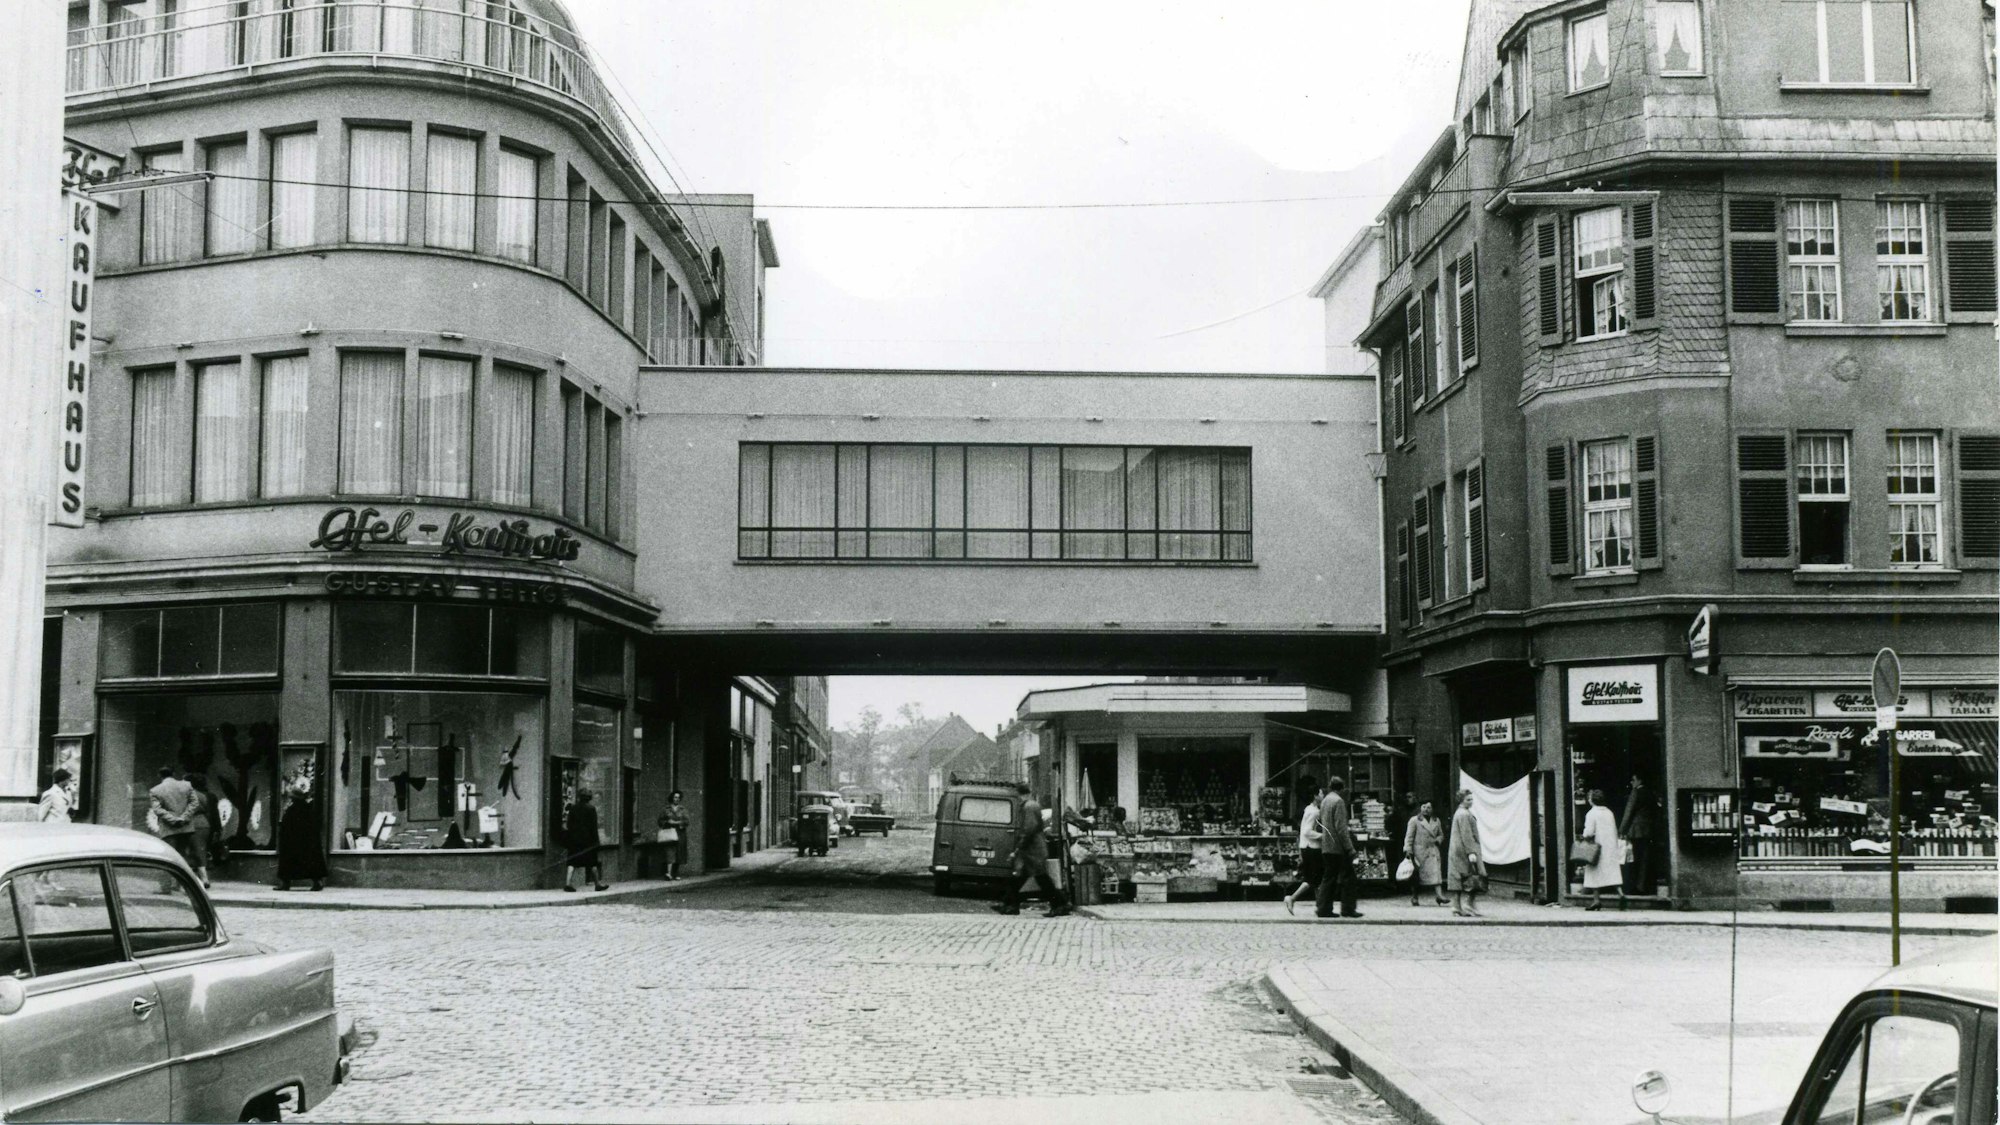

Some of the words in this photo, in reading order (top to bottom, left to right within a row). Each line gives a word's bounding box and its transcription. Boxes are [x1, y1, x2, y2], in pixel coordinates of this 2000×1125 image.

[62, 201, 91, 514] KAUFHAUS
[325, 571, 457, 599] GUSTAV
[1738, 692, 1805, 711] Zigarren
[1746, 707, 1807, 715] ZIGARETTEN
[1805, 725, 1854, 741] Rössli
